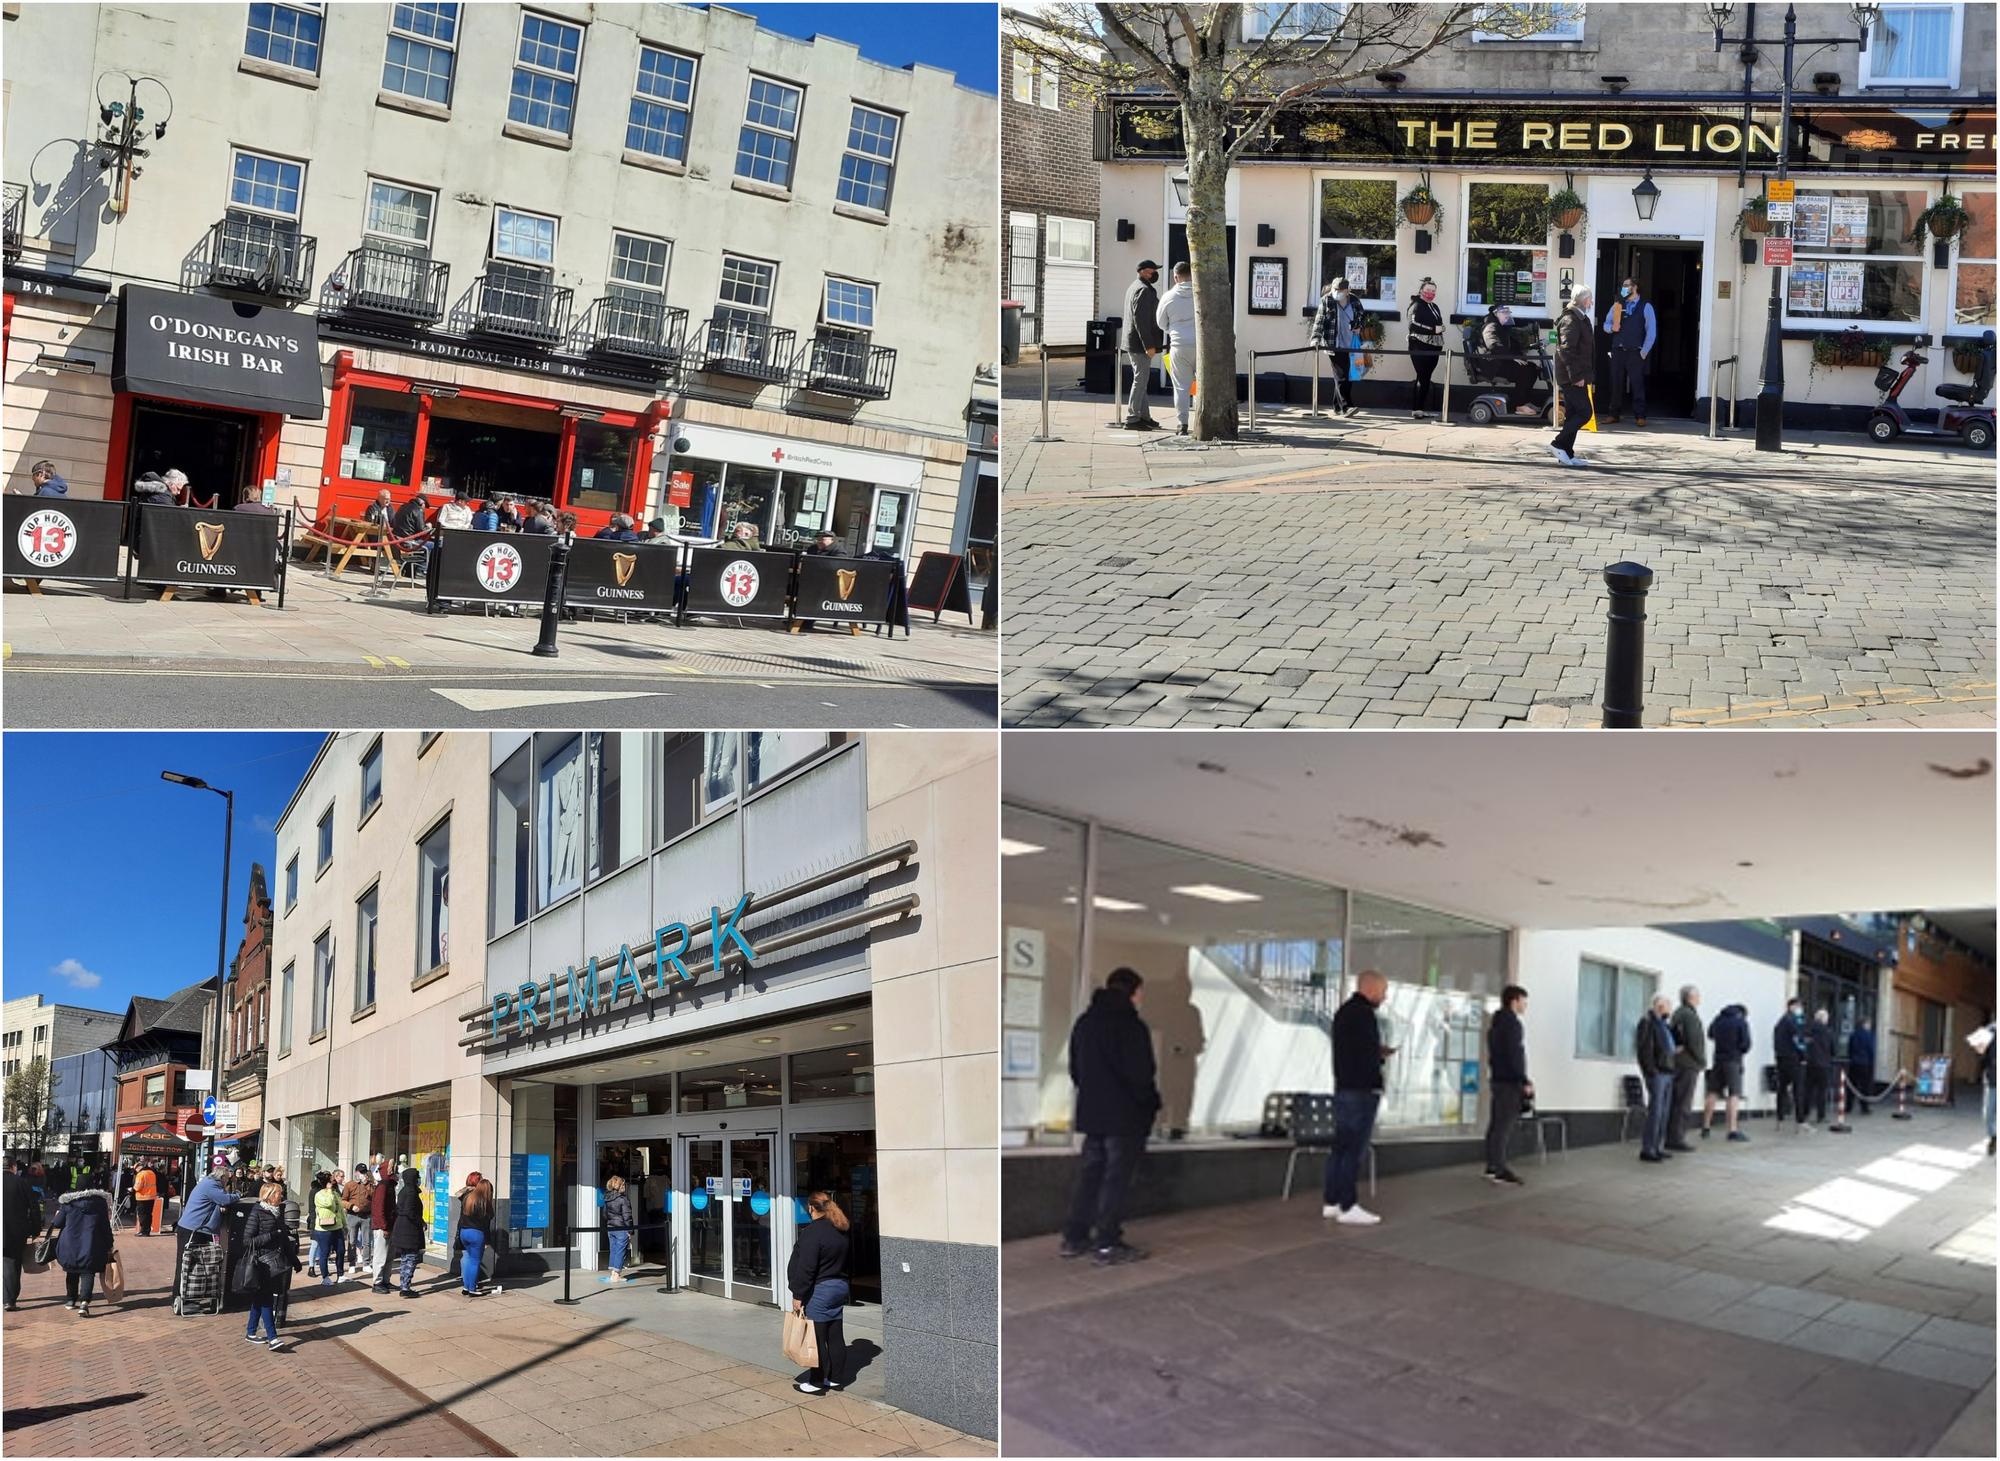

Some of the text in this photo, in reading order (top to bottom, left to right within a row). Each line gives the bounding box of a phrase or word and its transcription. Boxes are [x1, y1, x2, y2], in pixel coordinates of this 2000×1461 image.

[1398, 121, 1782, 153] THE RED LION
[1916, 133, 1997, 149] FRE
[22, 281, 54, 296] BAR
[1256, 285, 1280, 298] OPEN
[1831, 286, 1859, 300] OPEN
[149, 314, 299, 354] O'DONEGAN'S
[168, 341, 284, 375] IRISH BAR
[410, 339, 586, 376] TRADITIONAL IRISH BAR
[672, 479, 690, 490] Sale
[23, 514, 73, 539] HOP HOUSE
[32, 526, 66, 553] 13
[29, 550, 64, 563] LAGER
[481, 546, 519, 567] HOP HOUSE
[176, 560, 237, 576] GUINNESS
[488, 556, 513, 580] 13
[485, 577, 511, 589] LAGER
[728, 573, 752, 596] 13
[596, 586, 645, 600] GUINNESS
[822, 600, 863, 613] GUINNESS
[1014, 940, 1035, 968] S
[492, 891, 759, 1039] PRIMARK
[127, 1143, 145, 1152] Join
[146, 1144, 165, 1152] here
